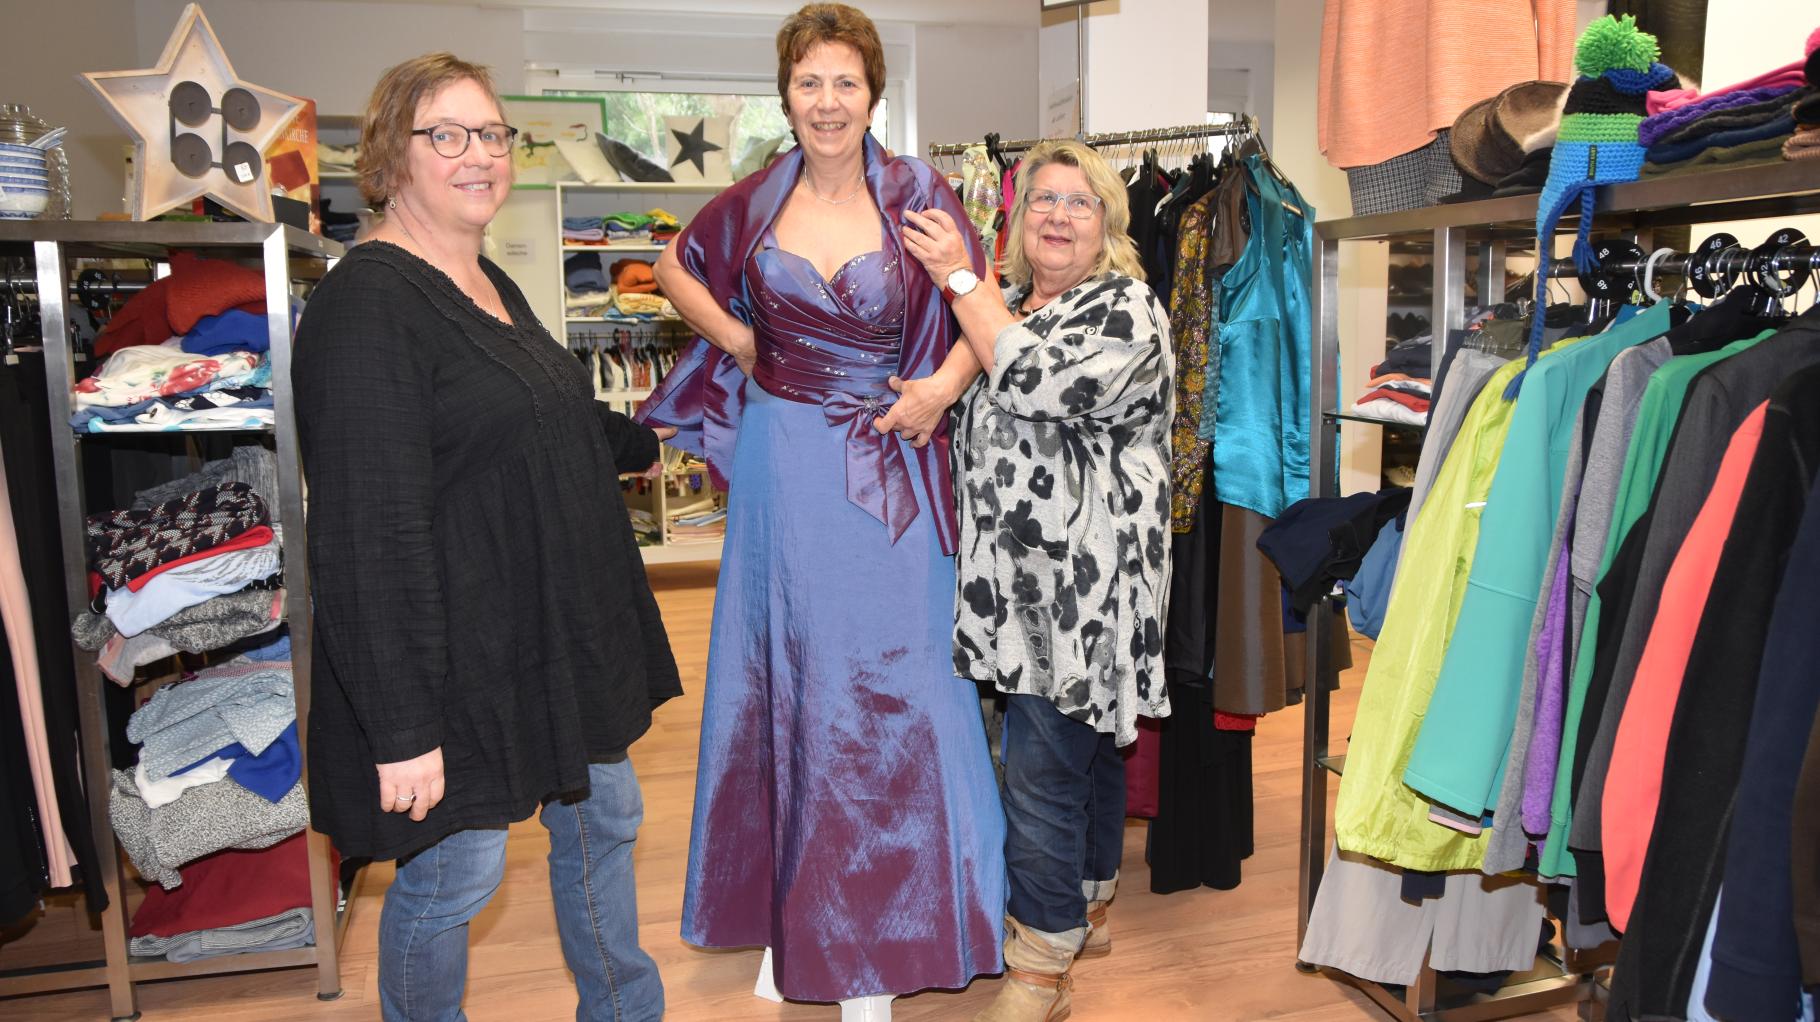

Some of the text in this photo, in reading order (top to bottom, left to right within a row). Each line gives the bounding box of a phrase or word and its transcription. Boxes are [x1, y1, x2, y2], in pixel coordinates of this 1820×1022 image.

[1709, 238, 1722, 250] 46
[1777, 234, 1789, 244] 42
[1599, 247, 1610, 259] 48
[1694, 266, 1703, 280] 46
[1597, 279, 1608, 290] 48
